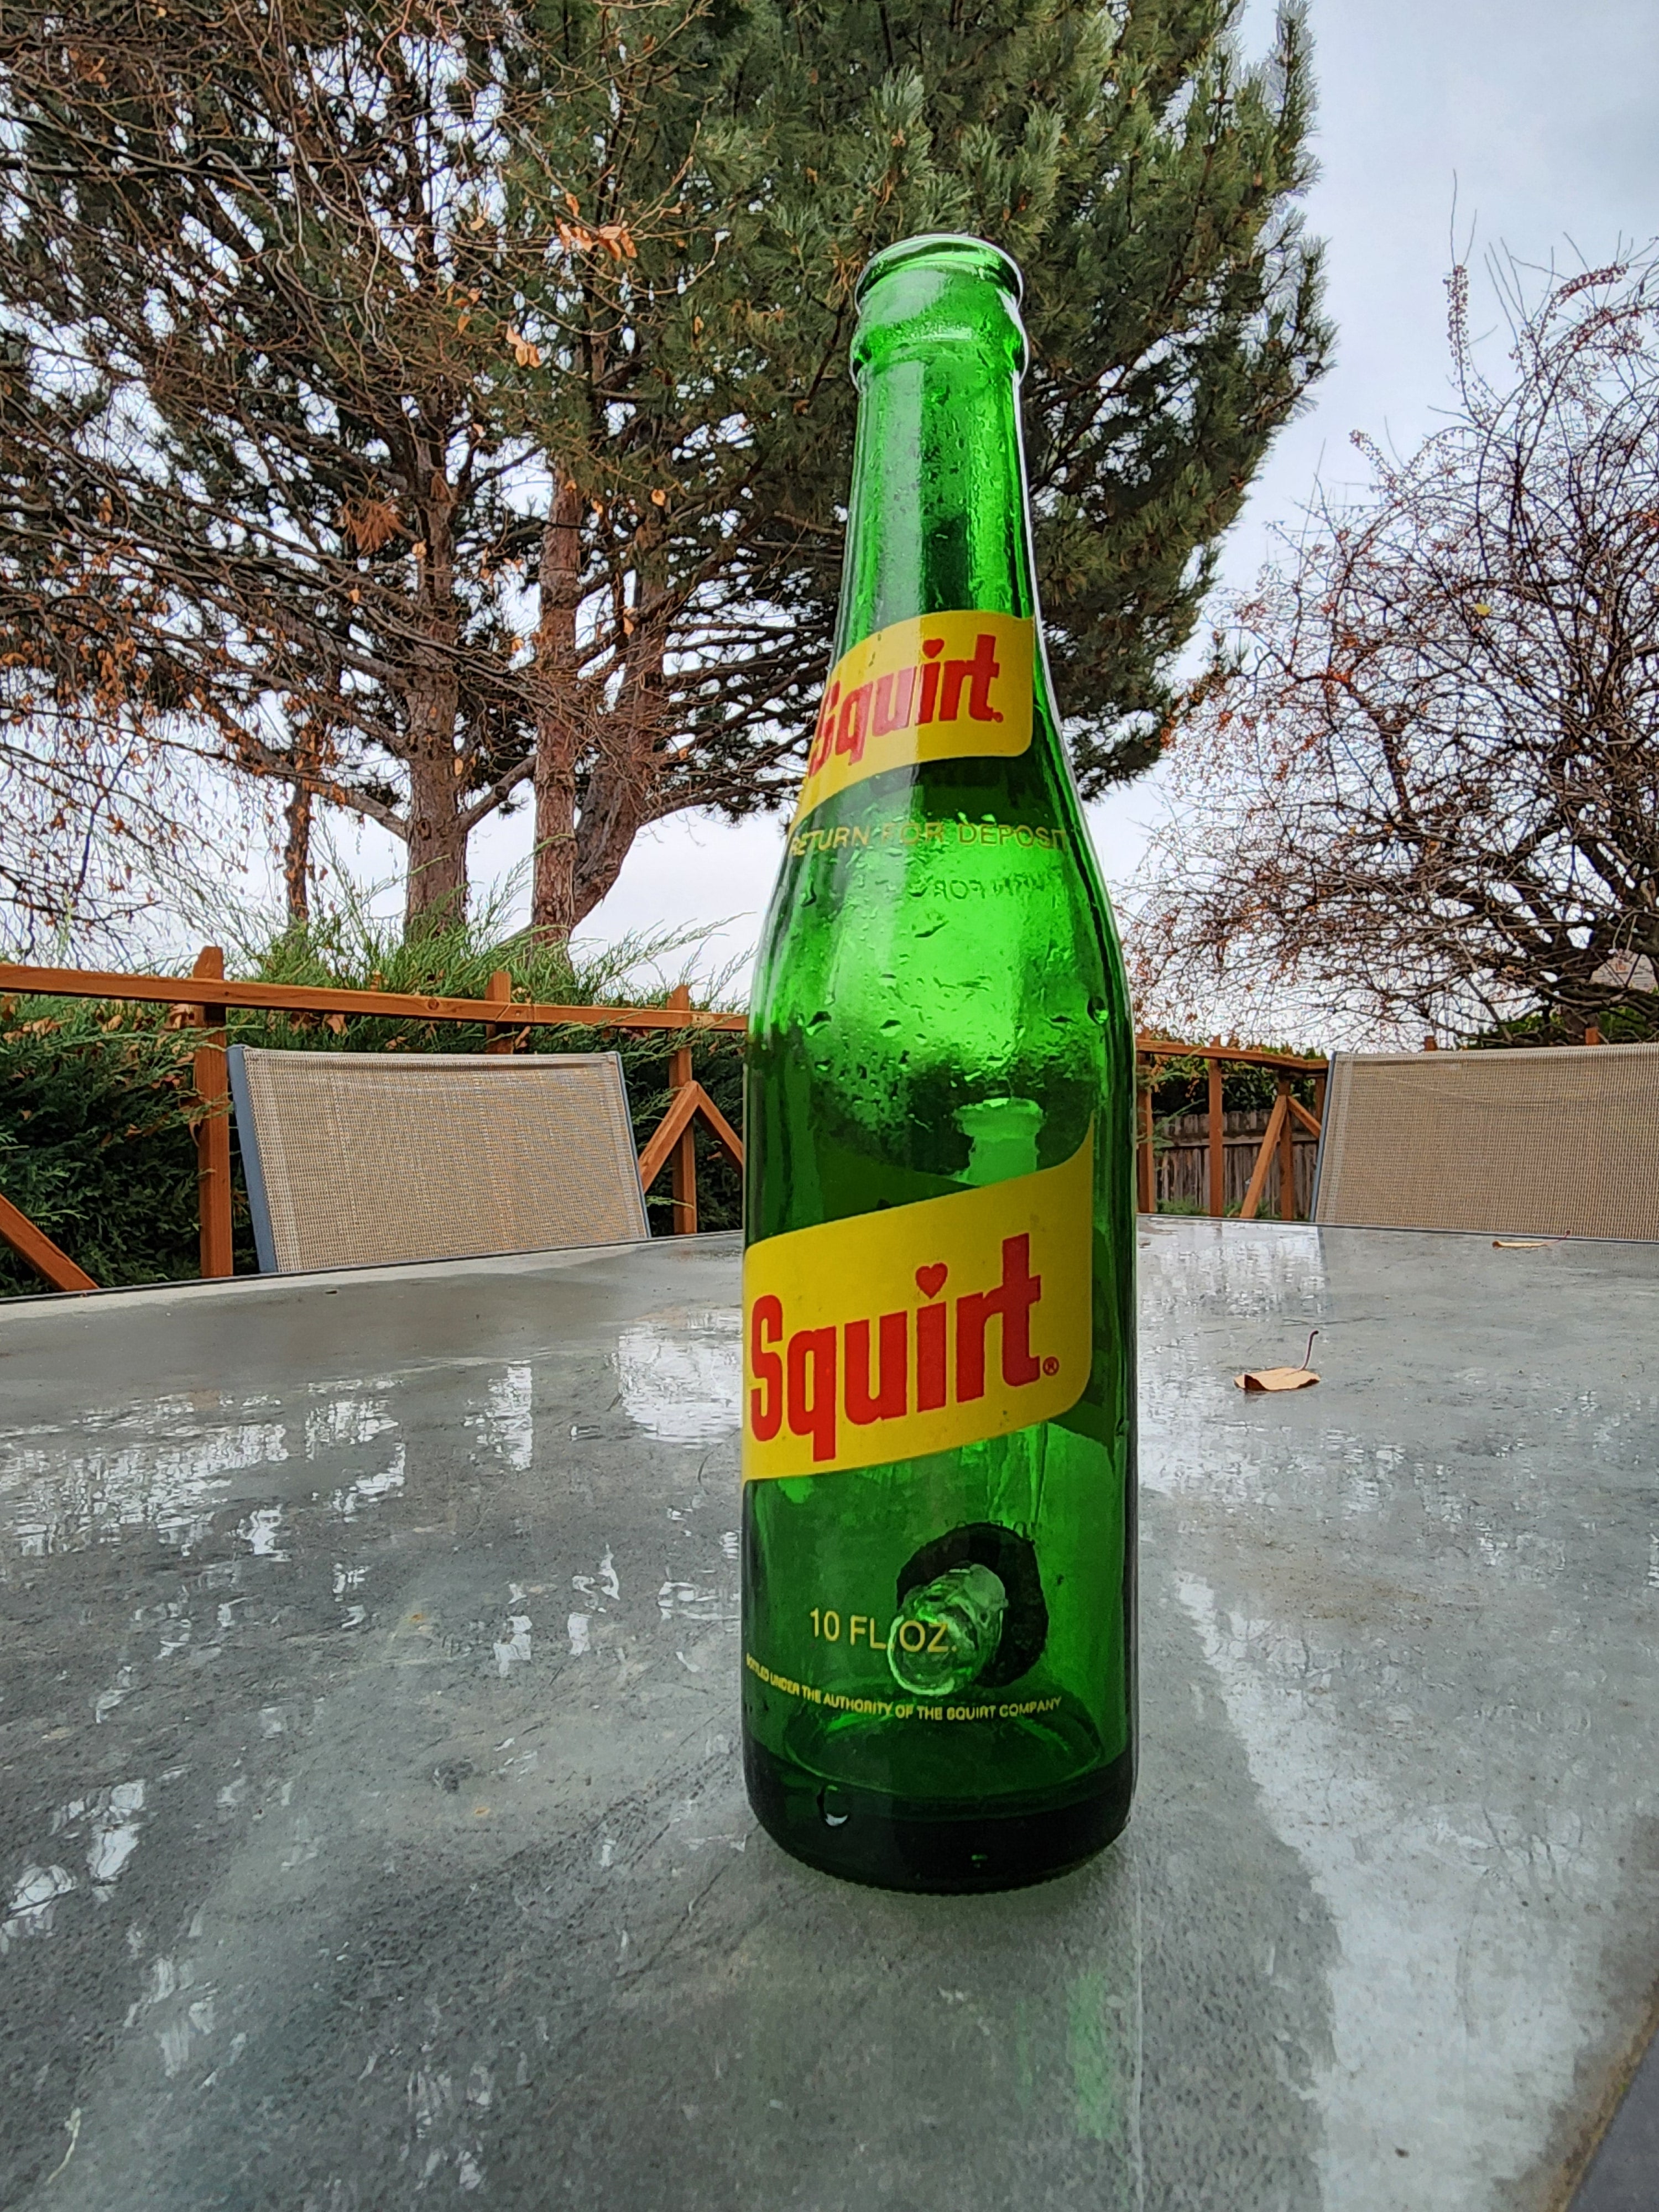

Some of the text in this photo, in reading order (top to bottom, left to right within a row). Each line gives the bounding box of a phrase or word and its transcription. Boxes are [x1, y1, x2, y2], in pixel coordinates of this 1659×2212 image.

[881, 821, 944, 846] FOR
[810, 1606, 840, 1642] 10
[899, 1620, 957, 1653] OZ.
[802, 1684, 822, 1704] THE
[823, 1692, 894, 1715] AUTHORITY
[895, 1703, 915, 1719] OF
[916, 1705, 943, 1721] THE
[946, 1705, 997, 1721] SQUIRT
[999, 1695, 1062, 1718] COMPANY
